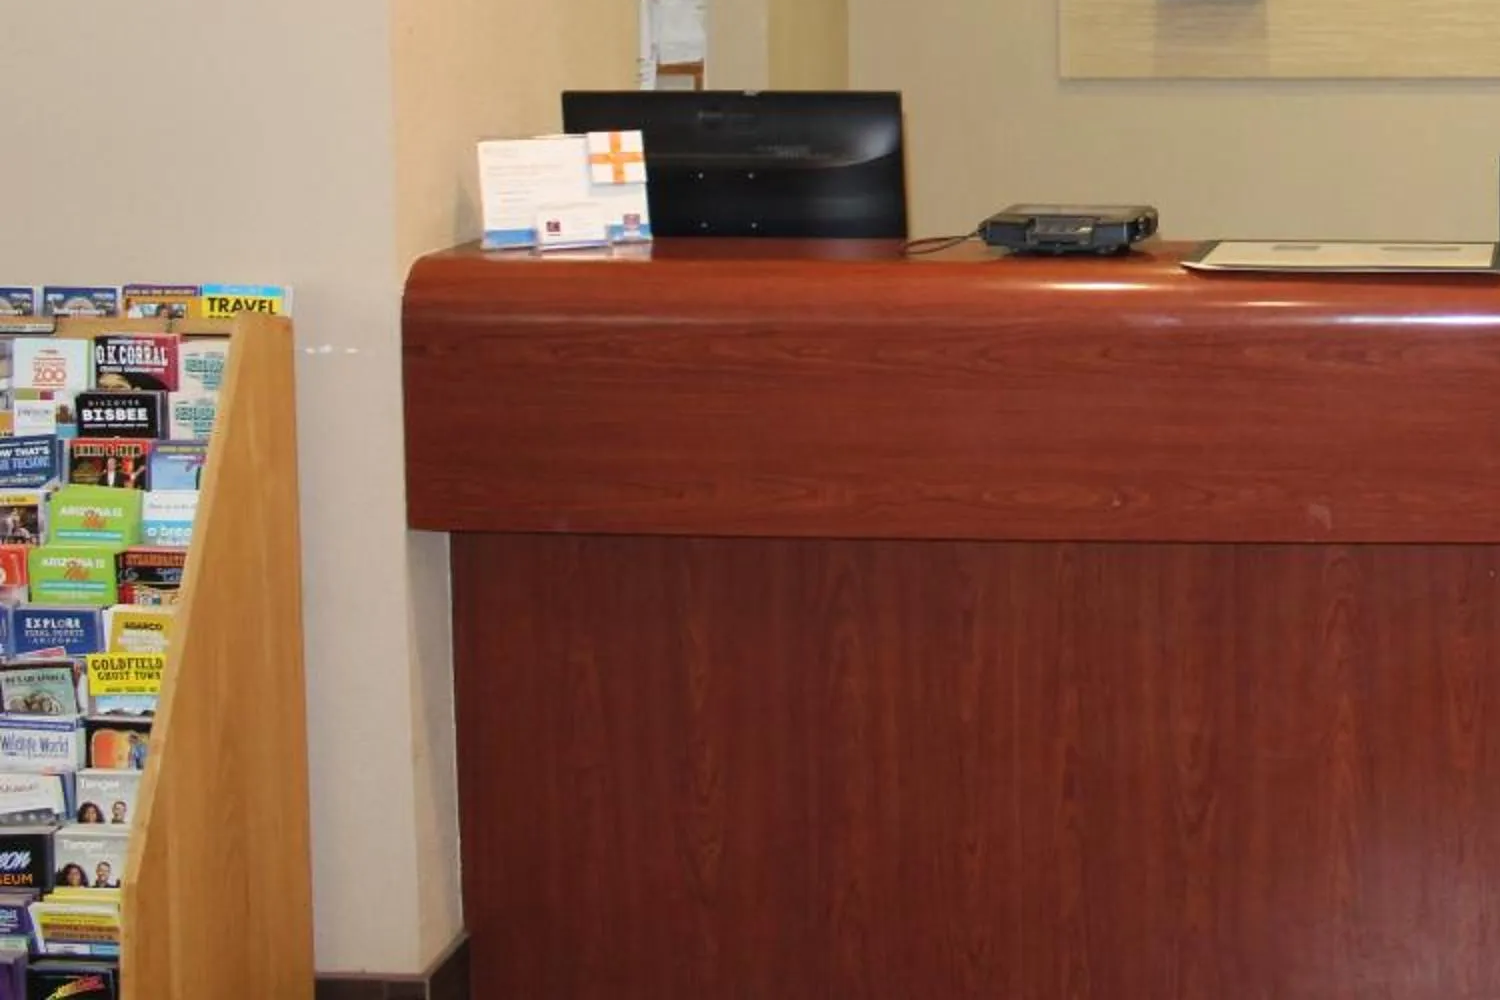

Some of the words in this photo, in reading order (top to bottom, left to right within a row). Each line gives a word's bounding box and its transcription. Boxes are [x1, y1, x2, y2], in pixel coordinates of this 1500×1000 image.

[207, 297, 278, 316] TRAVEL
[119, 345, 169, 367] CORRAL
[34, 367, 66, 382] ZOO
[82, 407, 148, 421] BISBEE
[25, 617, 81, 629] EXPLORE
[92, 657, 164, 671] GOLDFIELD
[97, 671, 131, 681] GHOST
[133, 671, 161, 681] TOWN
[39, 735, 69, 752] World
